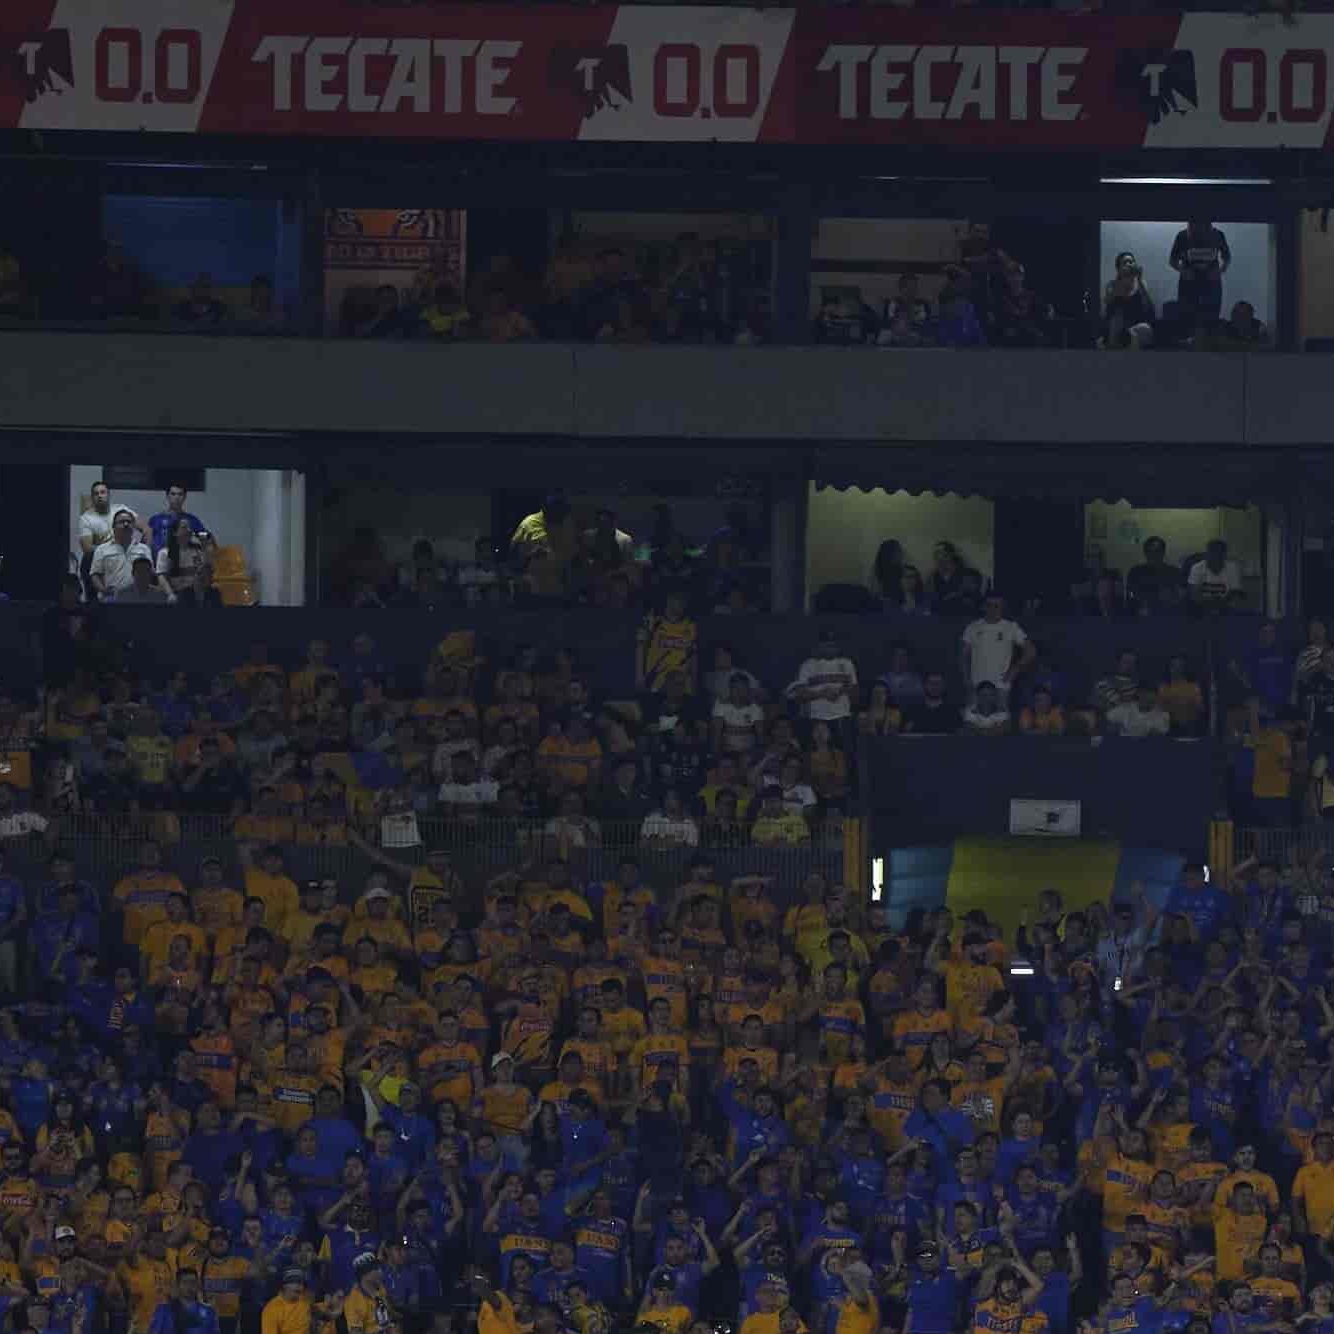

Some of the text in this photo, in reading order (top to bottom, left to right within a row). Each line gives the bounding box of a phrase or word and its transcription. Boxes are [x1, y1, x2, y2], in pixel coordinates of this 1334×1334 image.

[94, 27, 202, 104] 0.0
[252, 36, 523, 114] TECATE
[652, 43, 760, 119] 0.0
[816, 44, 1089, 121] TECATE
[1218, 47, 1327, 121] 0.0
